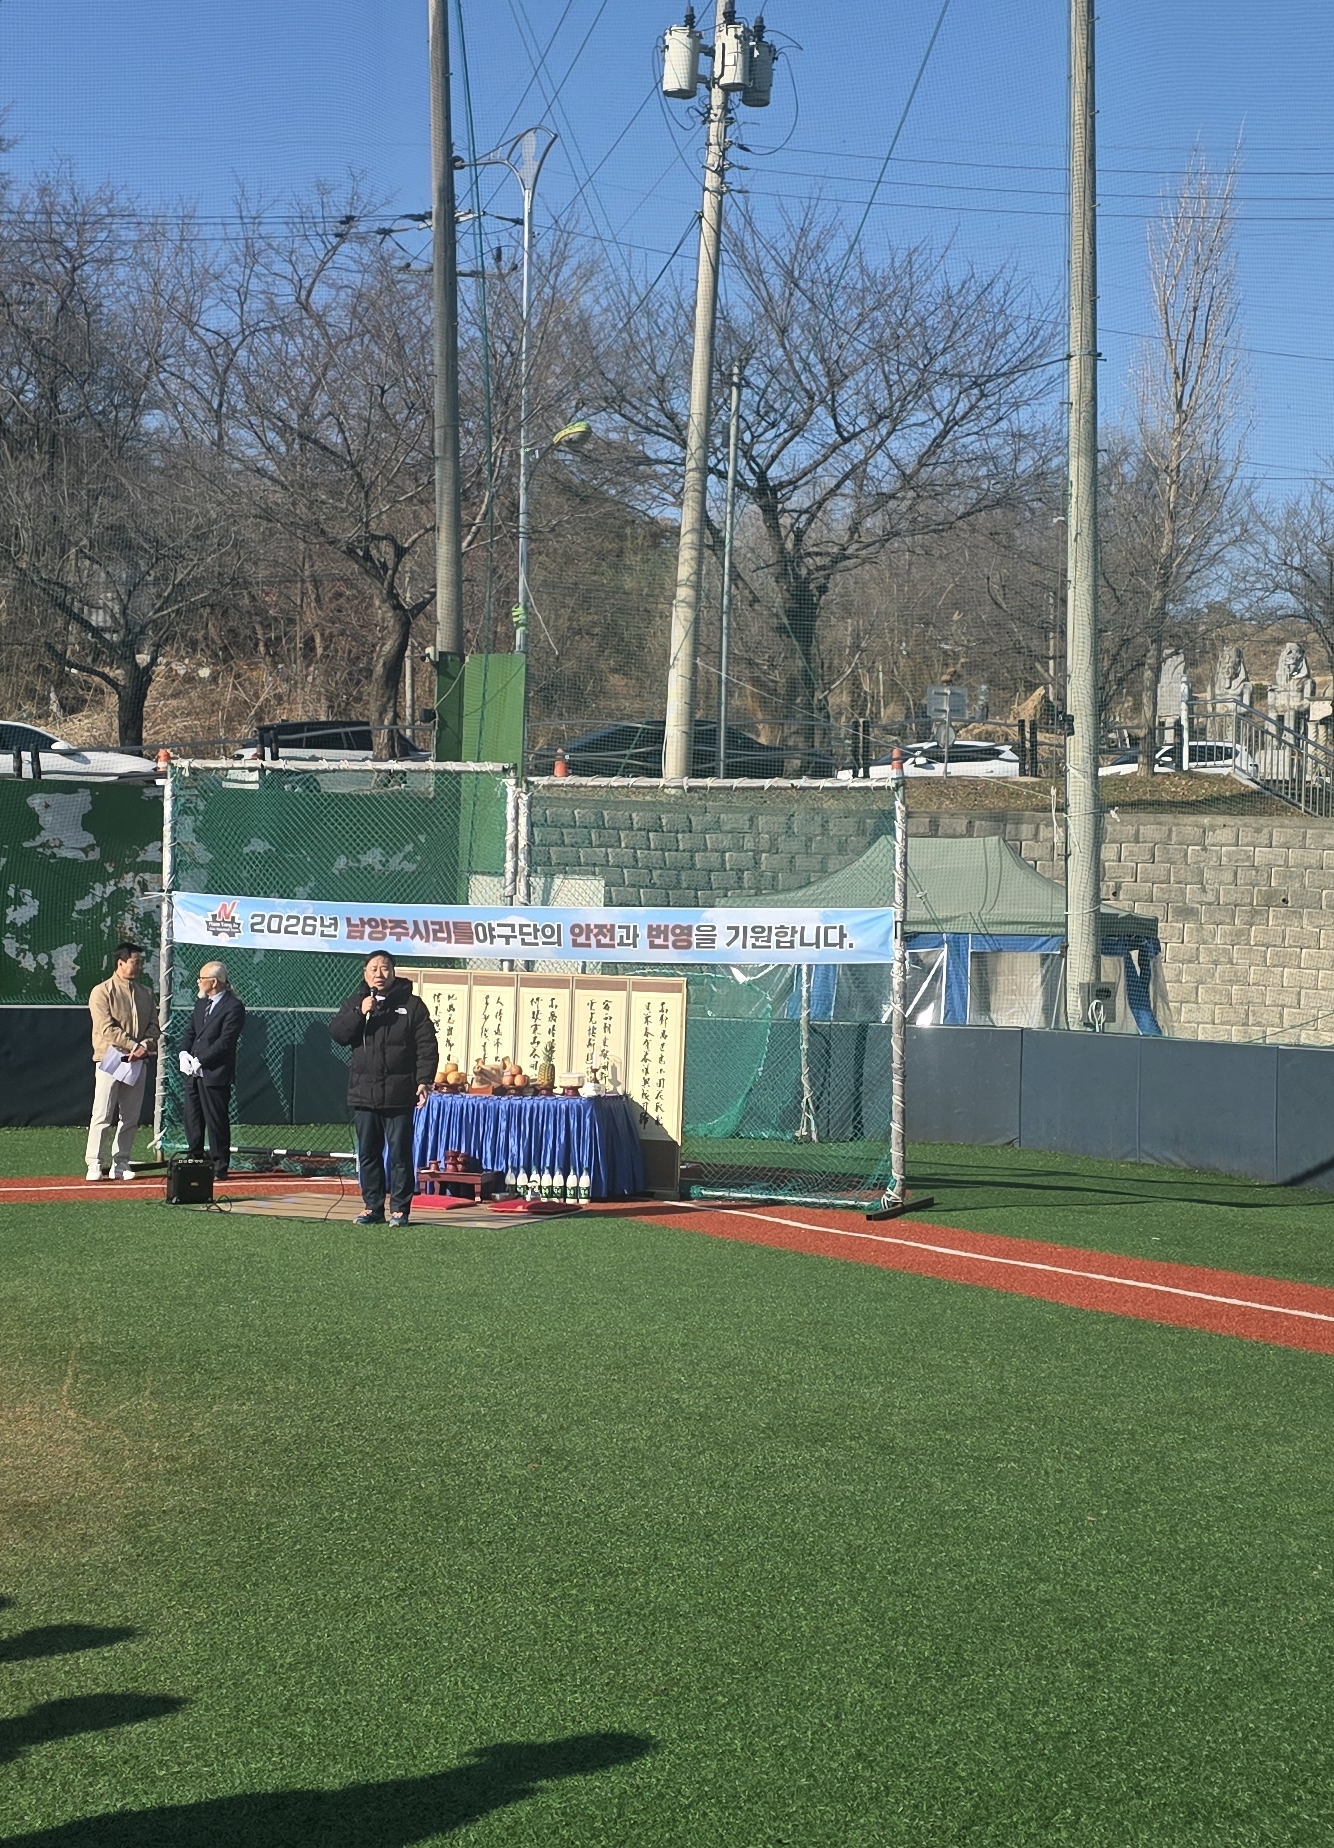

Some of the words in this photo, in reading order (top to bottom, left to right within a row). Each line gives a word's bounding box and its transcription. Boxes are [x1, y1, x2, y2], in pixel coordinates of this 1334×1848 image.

[217, 901, 238, 920] N
[250, 913, 338, 938] 2026년
[345, 916, 562, 947] 남양주시리틀야구단의
[569, 922, 640, 949] 안전과
[646, 923, 717, 950] 번영을
[725, 924, 855, 950] 기원합니다.
